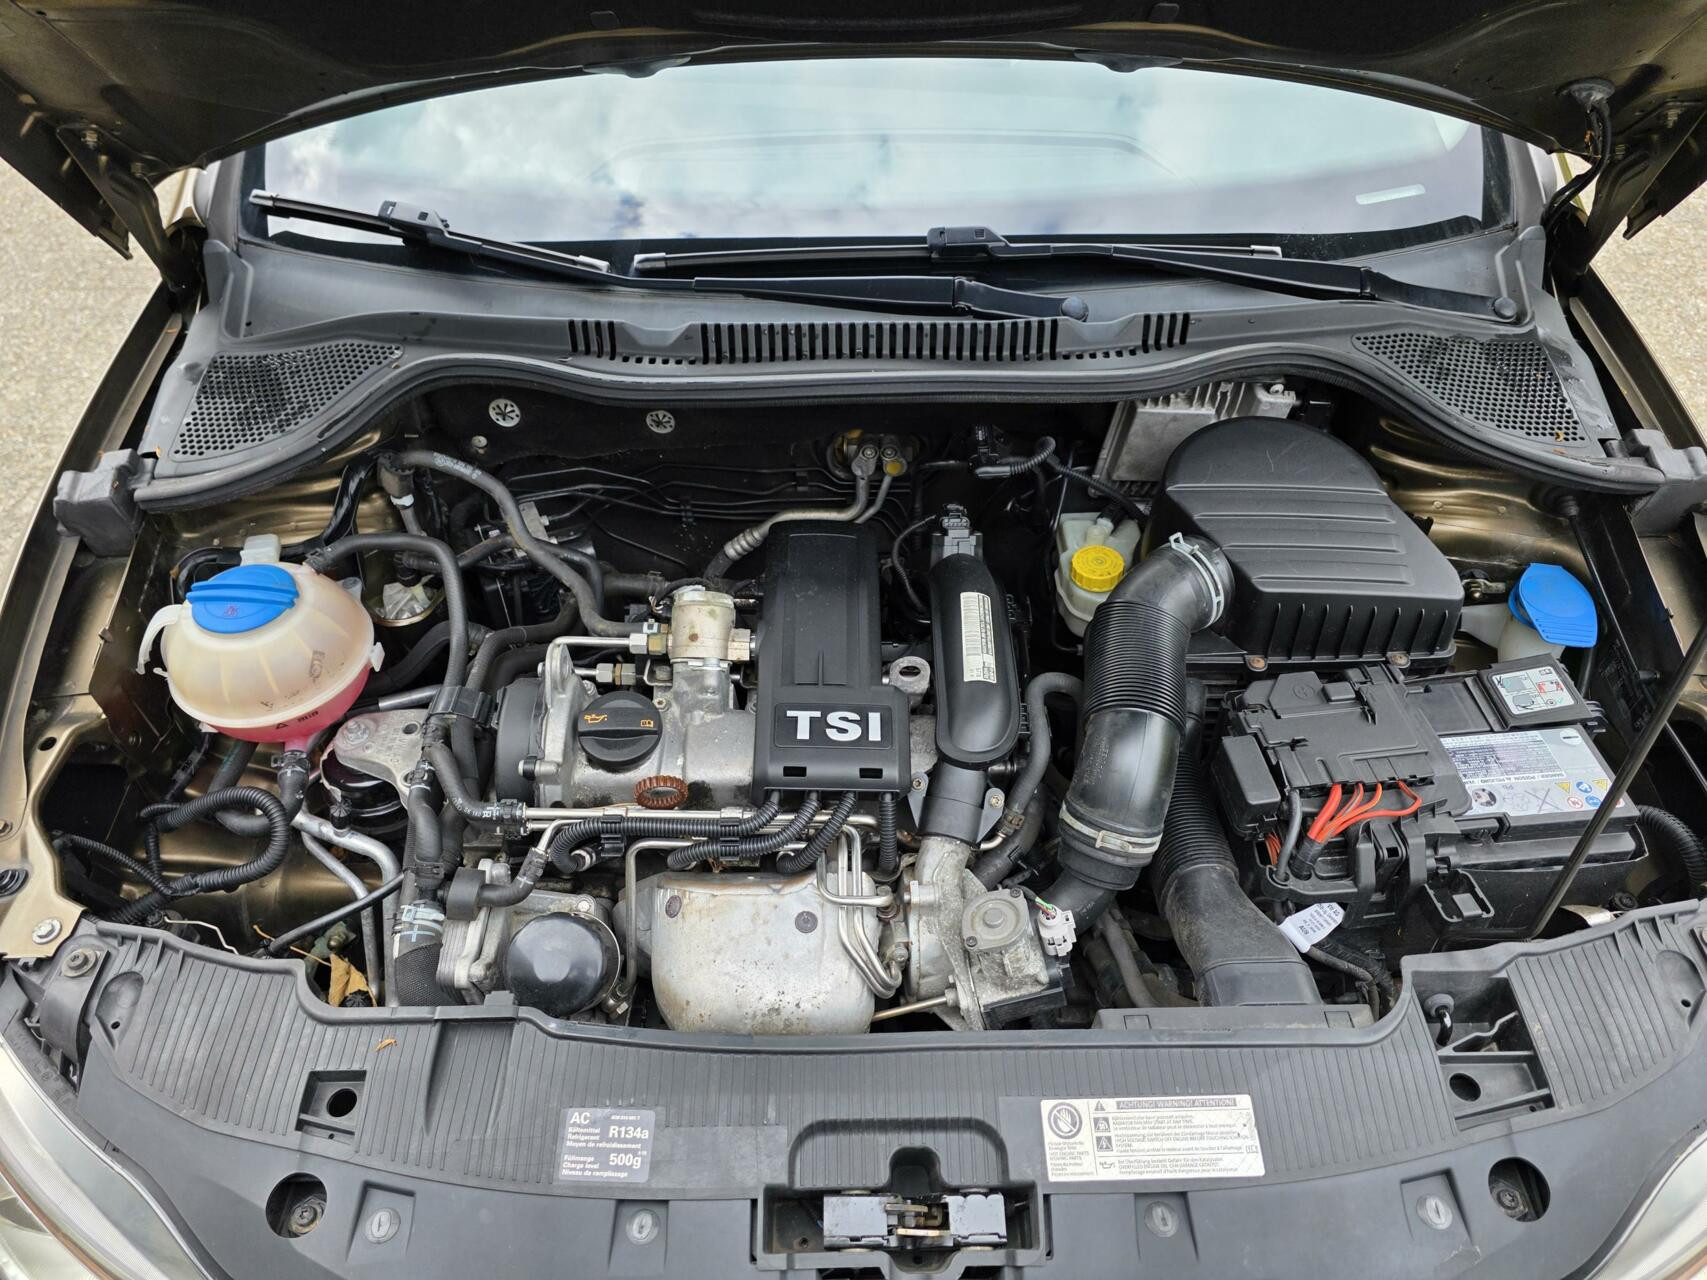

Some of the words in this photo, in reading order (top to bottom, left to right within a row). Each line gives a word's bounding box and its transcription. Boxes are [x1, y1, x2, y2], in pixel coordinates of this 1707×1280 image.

[786, 710, 881, 741] TSI
[1120, 1101, 1155, 1109] ACHTUNG!
[1156, 1100, 1192, 1108] WARNING!
[1194, 1098, 1235, 1107] ATTENTION!
[570, 1112, 590, 1124] AC
[567, 1133, 600, 1141] Refrigerant
[609, 1125, 649, 1139] R134a
[609, 1153, 642, 1169] 500g
